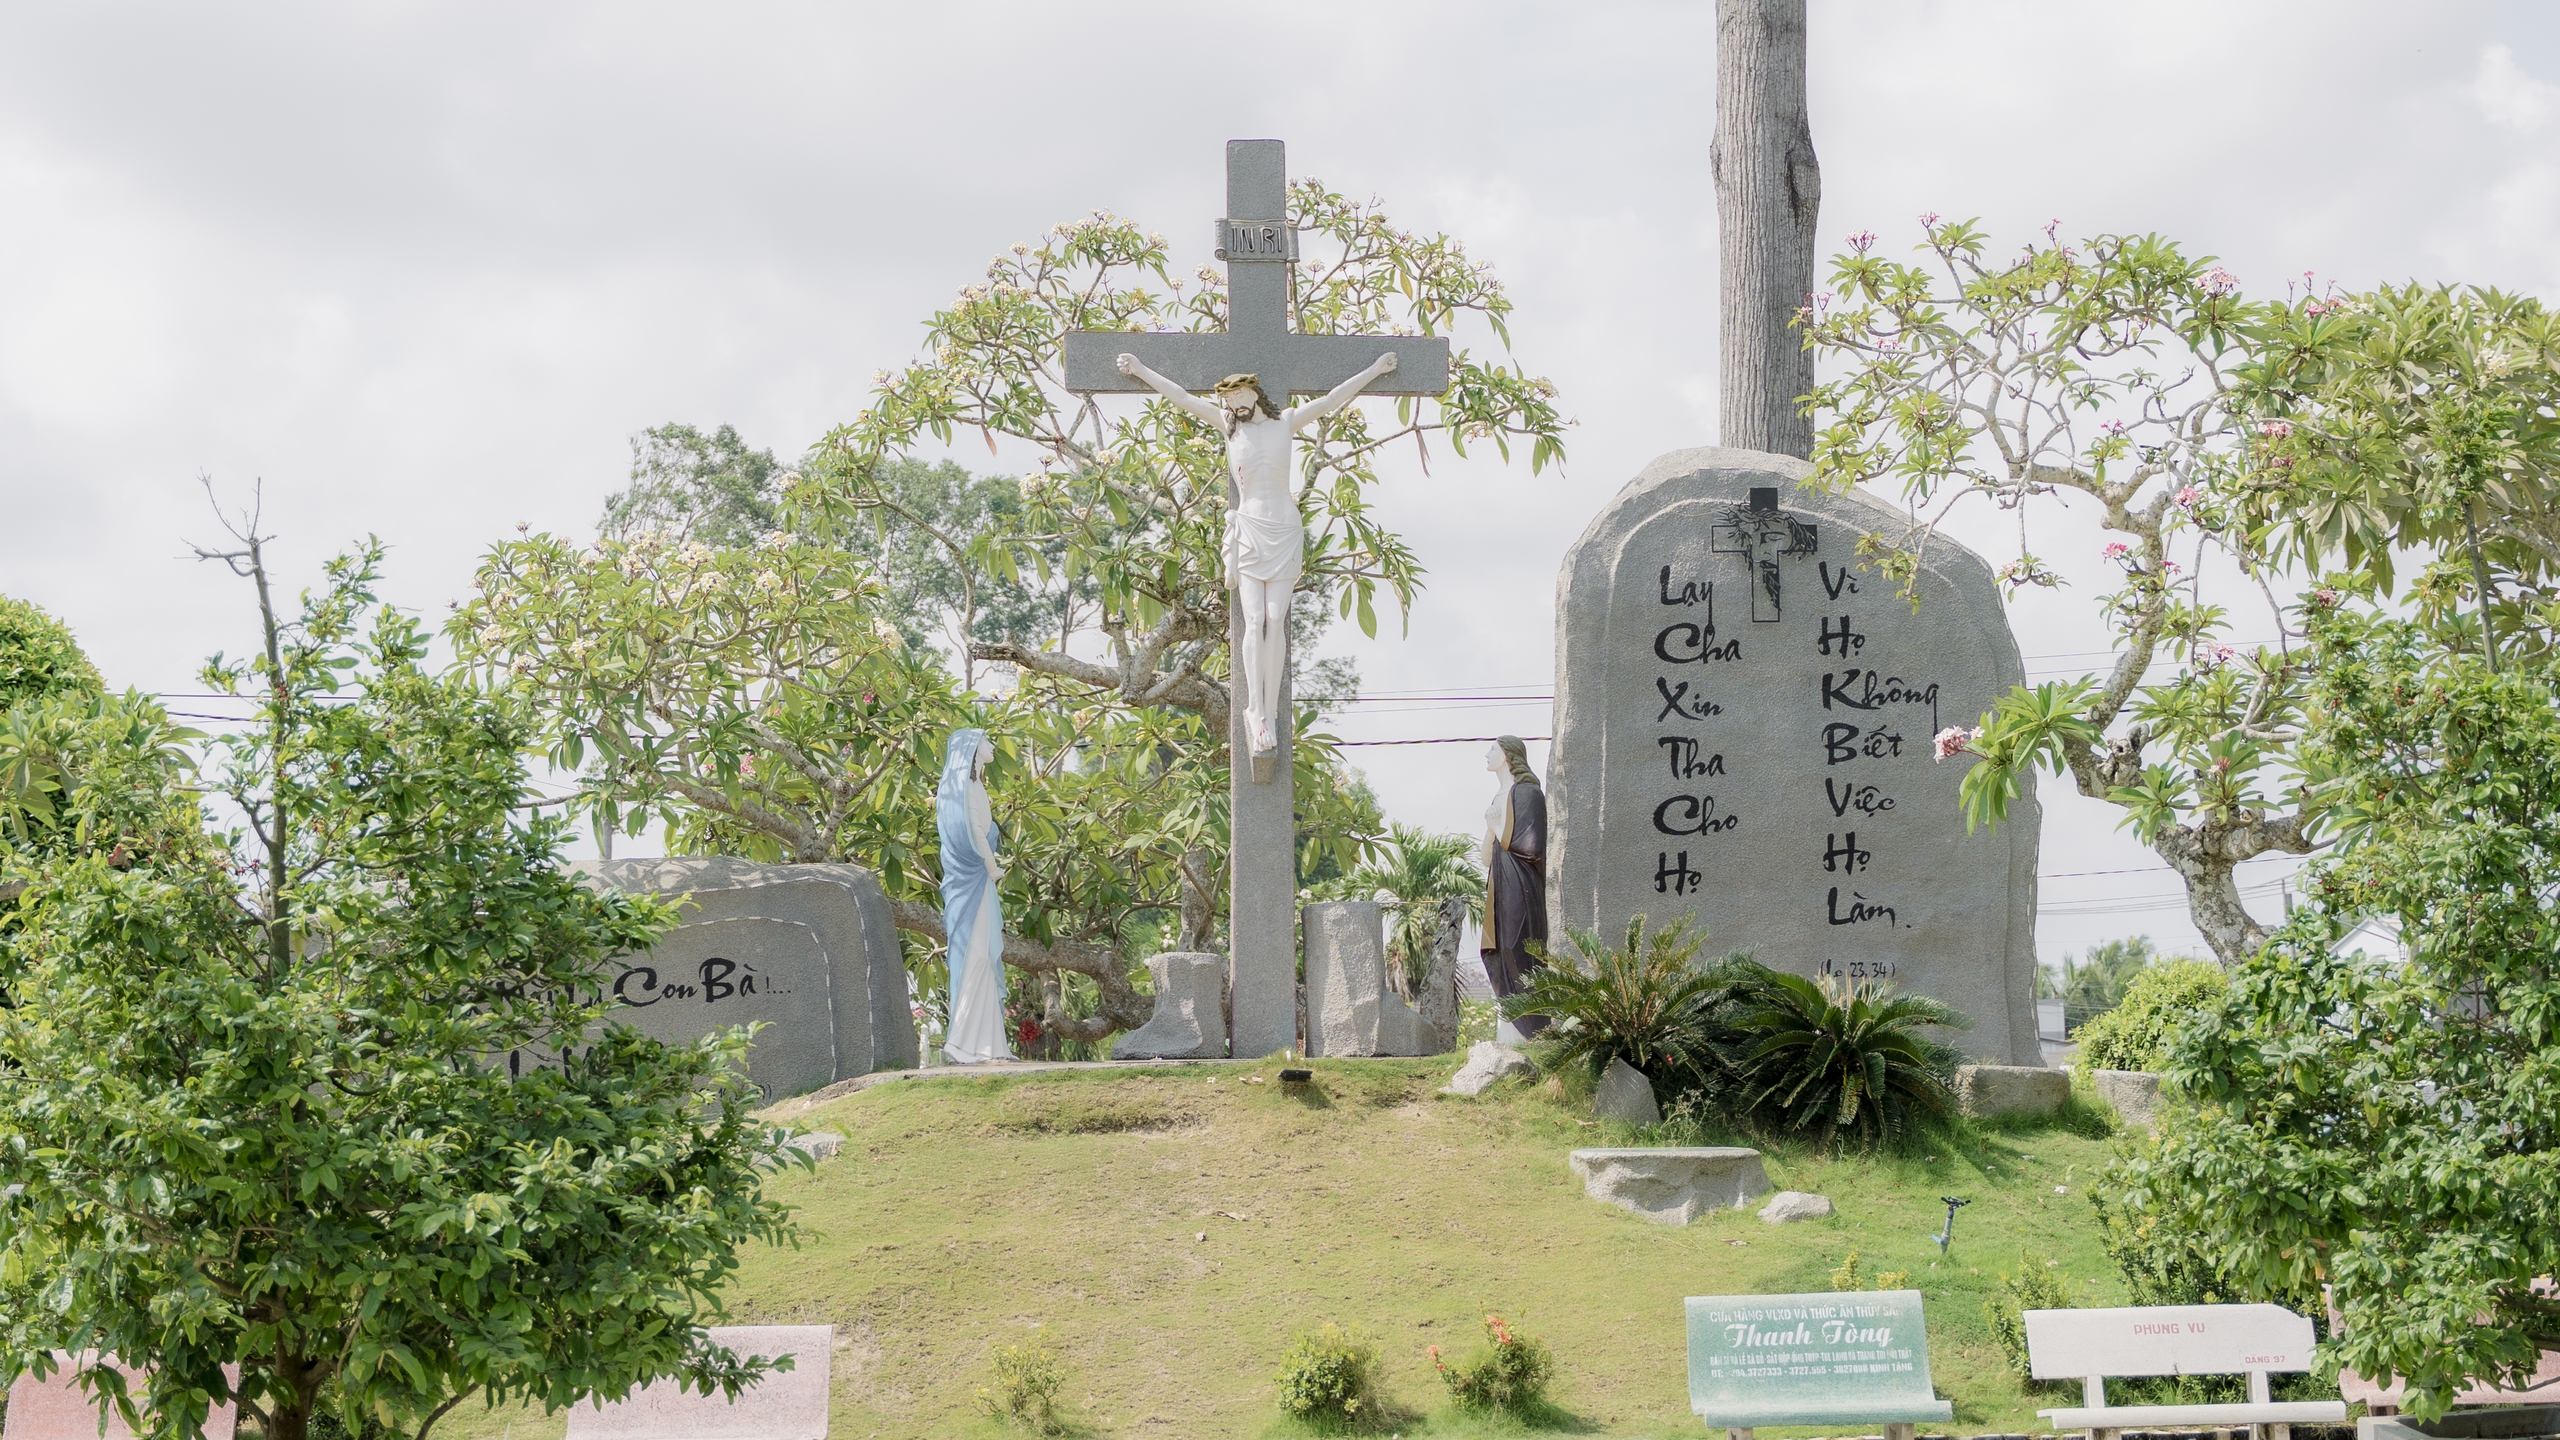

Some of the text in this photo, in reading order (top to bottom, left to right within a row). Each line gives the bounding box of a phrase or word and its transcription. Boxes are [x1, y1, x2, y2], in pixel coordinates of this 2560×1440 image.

[1232, 227, 1282, 253] INRI
[1659, 564, 1713, 628] Lạy
[1818, 560, 1860, 600] Vì
[1653, 622, 1743, 664] Cha
[1818, 614, 1866, 660] Họ
[1656, 676, 1725, 723] Xin
[1821, 668, 1939, 737] Không
[1658, 736, 1727, 781] Tha
[1821, 722, 1905, 766] Biết
[1652, 794, 1739, 836] Cho
[1825, 777, 1898, 818] Việc
[1654, 850, 1702, 897] Họ
[1823, 831, 1871, 876] Họ
[613, 966, 699, 1008] Con
[1734, 1307, 1764, 1321] HÀNG
[1765, 1308, 1792, 1320] VLXD
[1793, 1305, 1808, 1319] VÀ
[1810, 1304, 1837, 1319] THỨC
[1723, 1320, 1894, 1348] Thanh Tòng
[2273, 1355, 2286, 1363] 97
